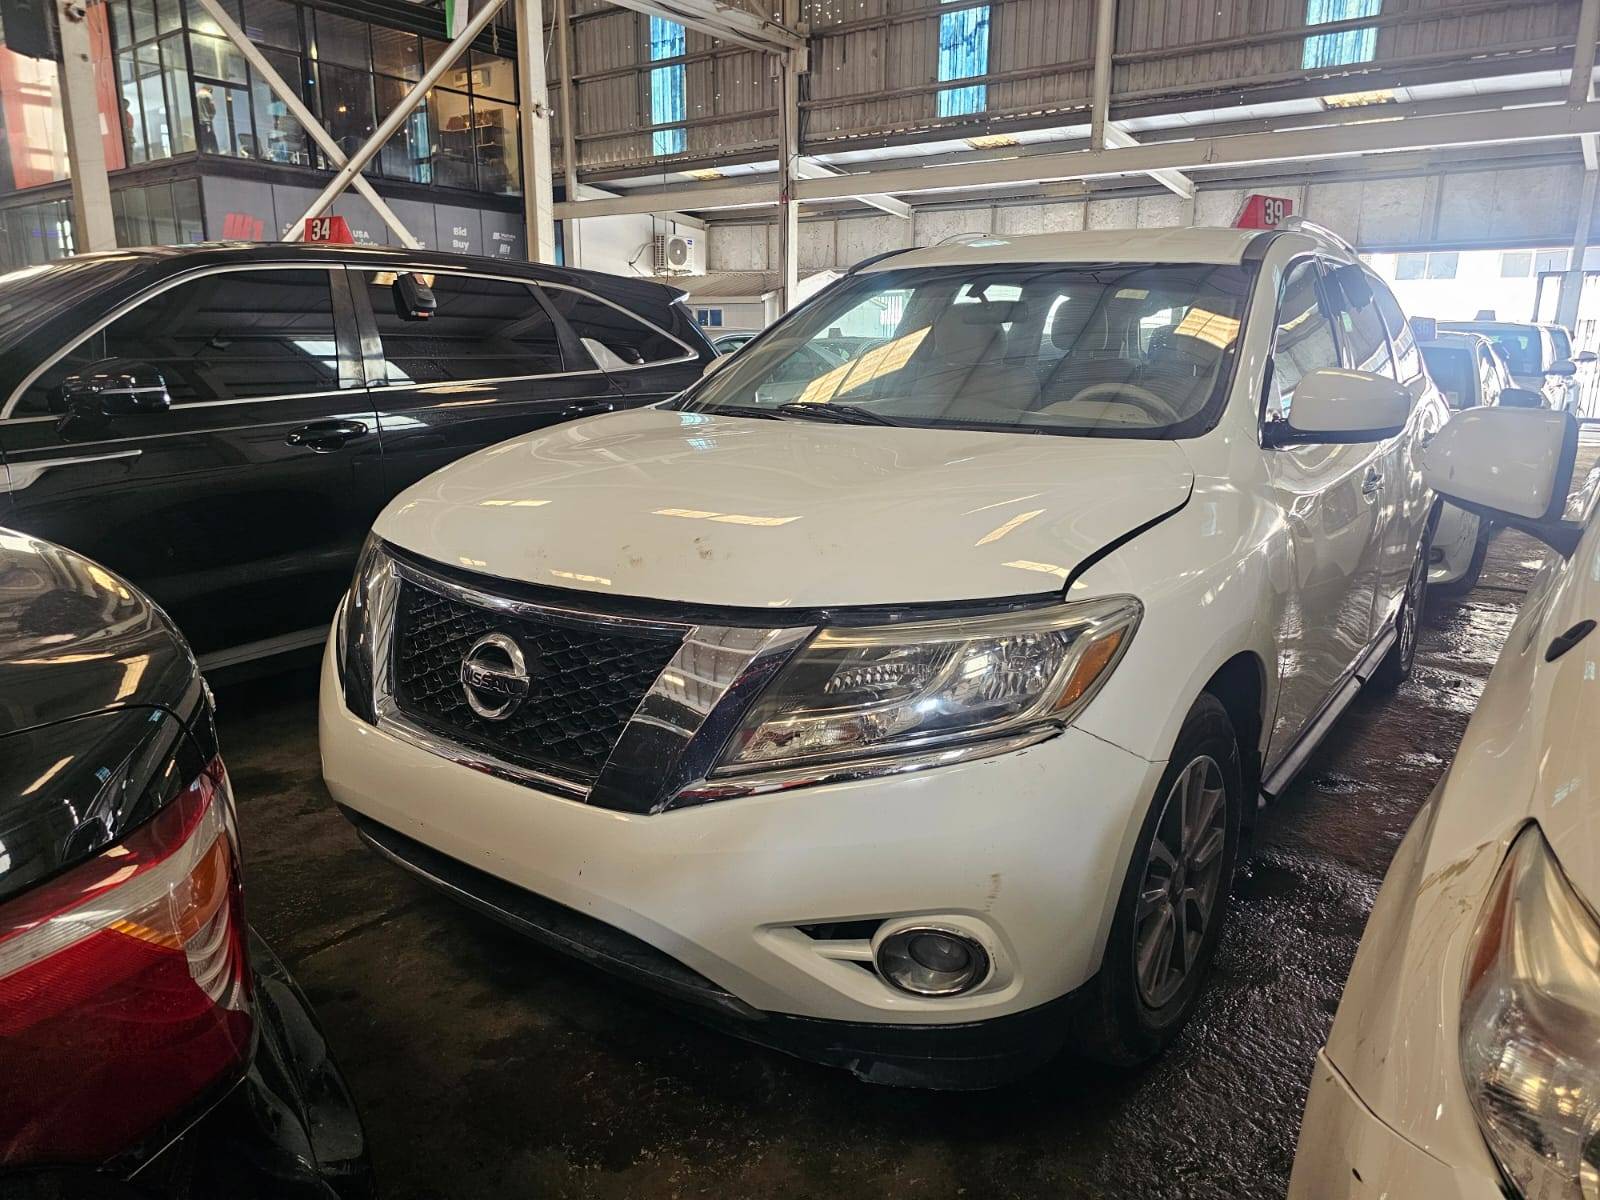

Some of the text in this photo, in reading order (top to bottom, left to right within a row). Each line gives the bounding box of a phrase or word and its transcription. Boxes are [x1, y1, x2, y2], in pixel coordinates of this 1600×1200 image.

[1265, 198, 1283, 224] 39
[311, 218, 331, 241] 34
[352, 229, 370, 239] USA
[453, 226, 467, 237] Bid
[452, 239, 470, 251] Buy
[461, 665, 517, 695] NISSAN
